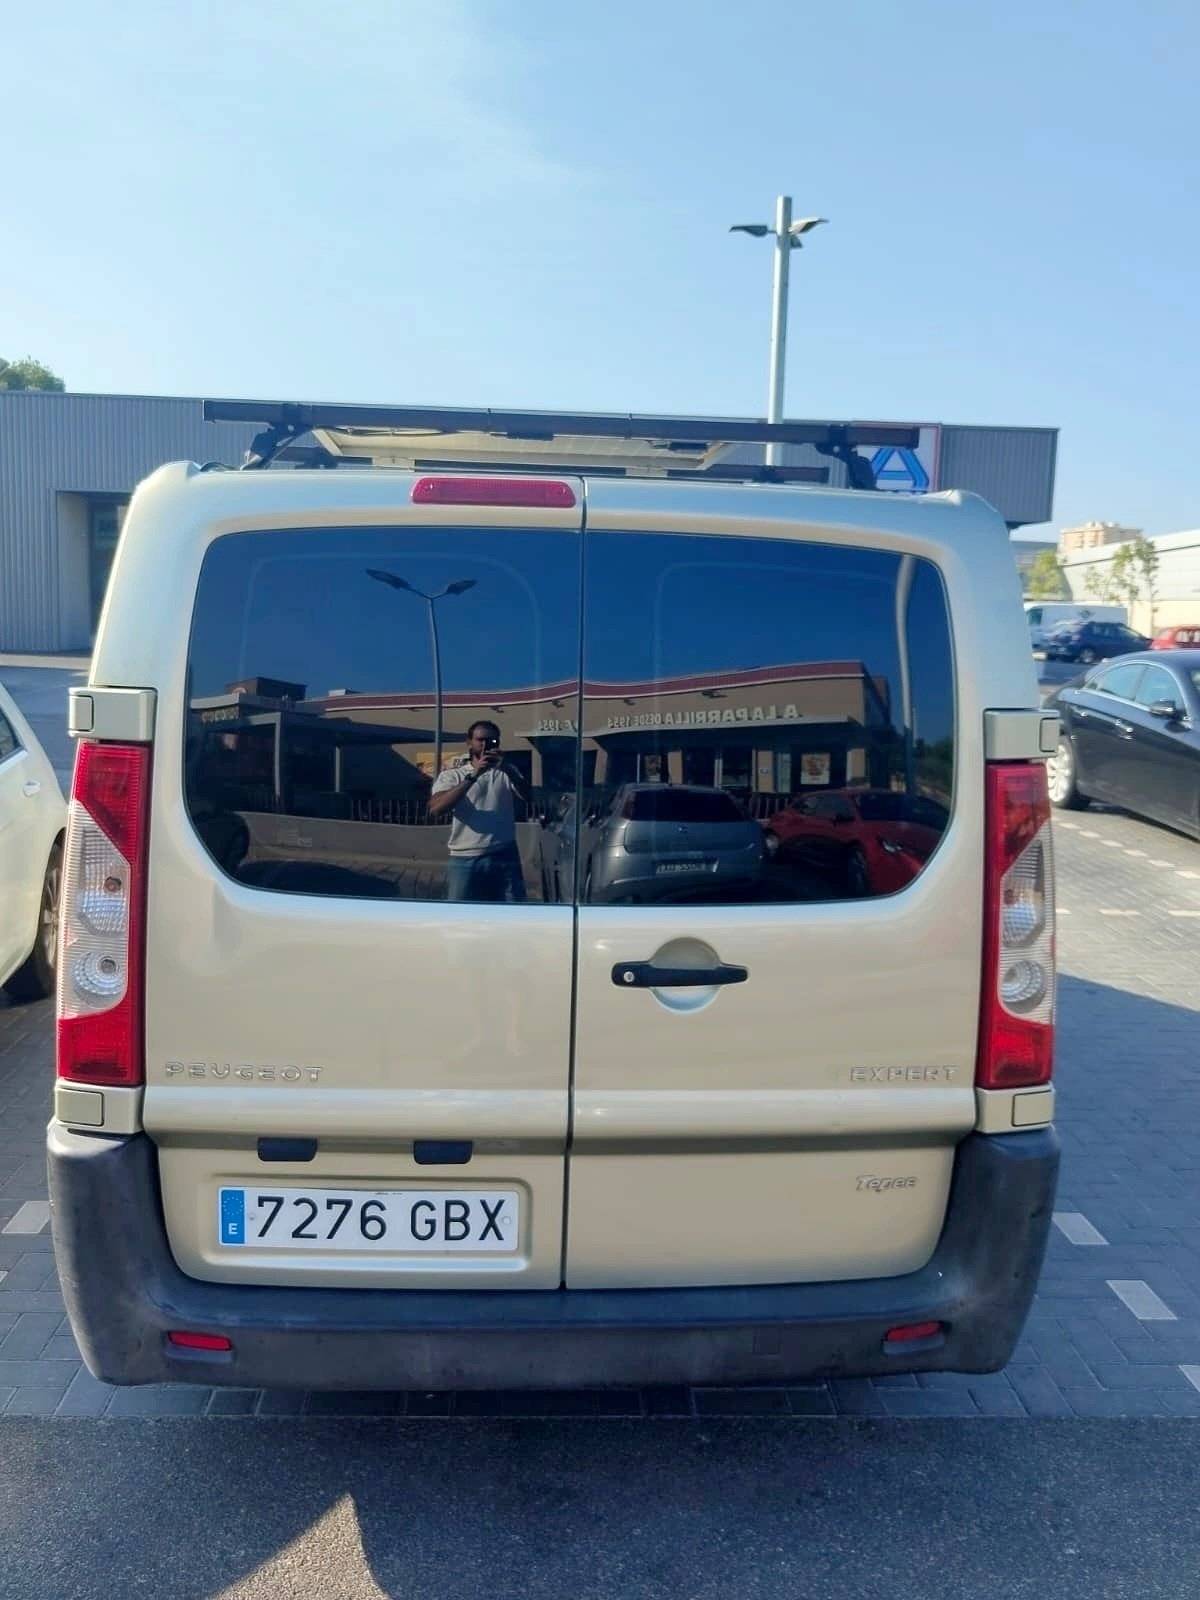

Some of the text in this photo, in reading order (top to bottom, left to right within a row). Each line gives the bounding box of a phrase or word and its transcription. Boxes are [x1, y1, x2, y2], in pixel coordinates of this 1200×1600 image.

[165, 1061, 322, 1082] PEUGEOT
[850, 1065, 958, 1081] EXPERT
[257, 1196, 505, 1241] 7276 GBX
[228, 1223, 238, 1235] E
